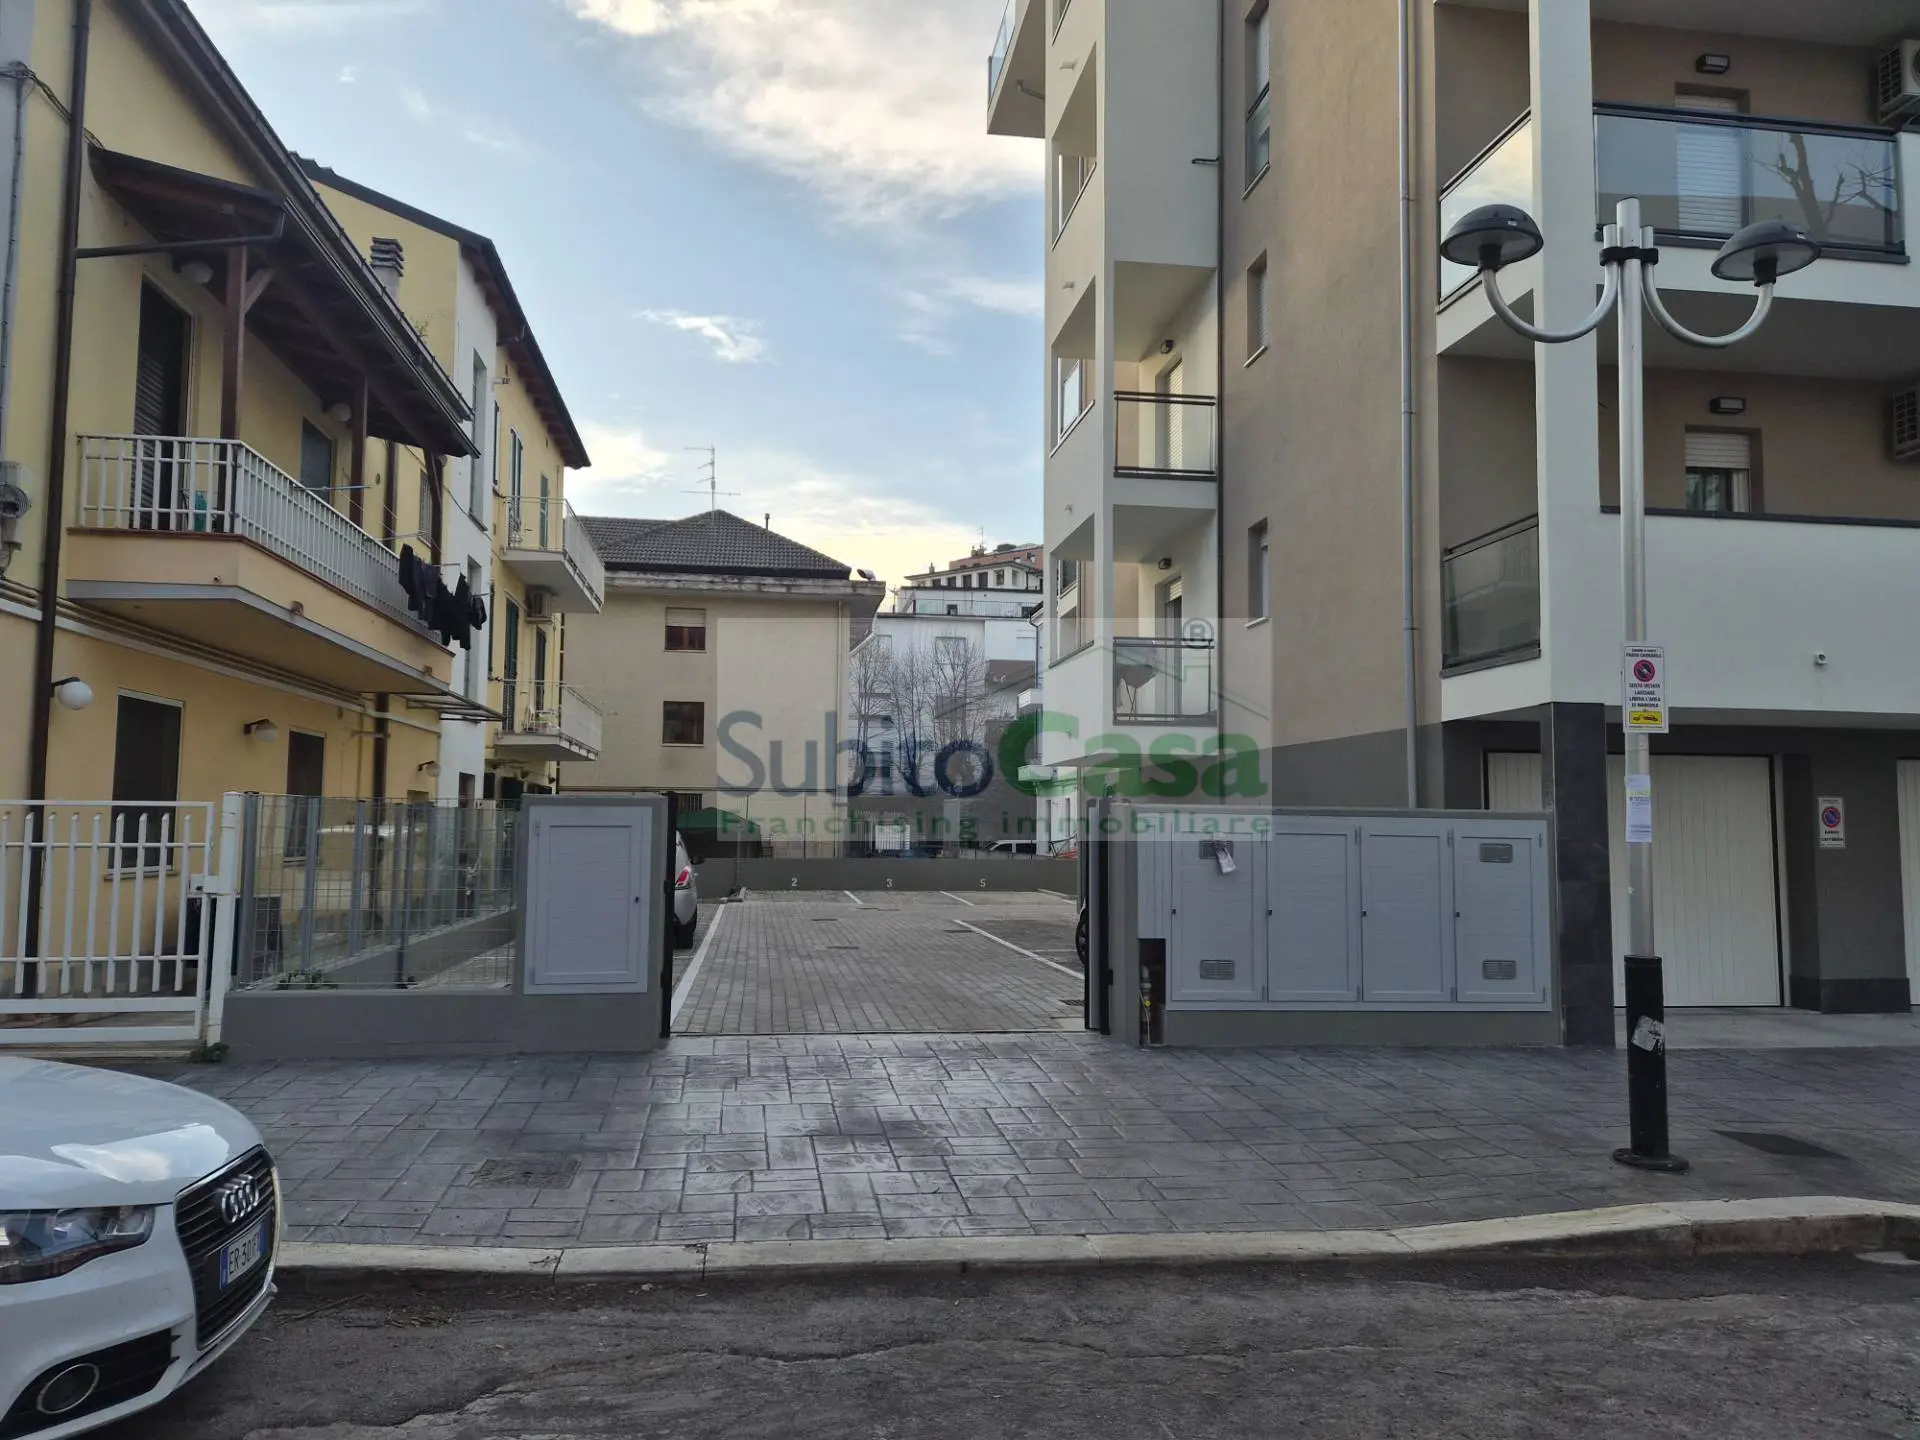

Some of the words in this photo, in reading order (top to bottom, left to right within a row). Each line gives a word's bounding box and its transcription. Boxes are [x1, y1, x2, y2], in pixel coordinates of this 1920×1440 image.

[791, 877, 799, 888] 2
[886, 878, 893, 888] 3
[980, 878, 987, 889] 5
